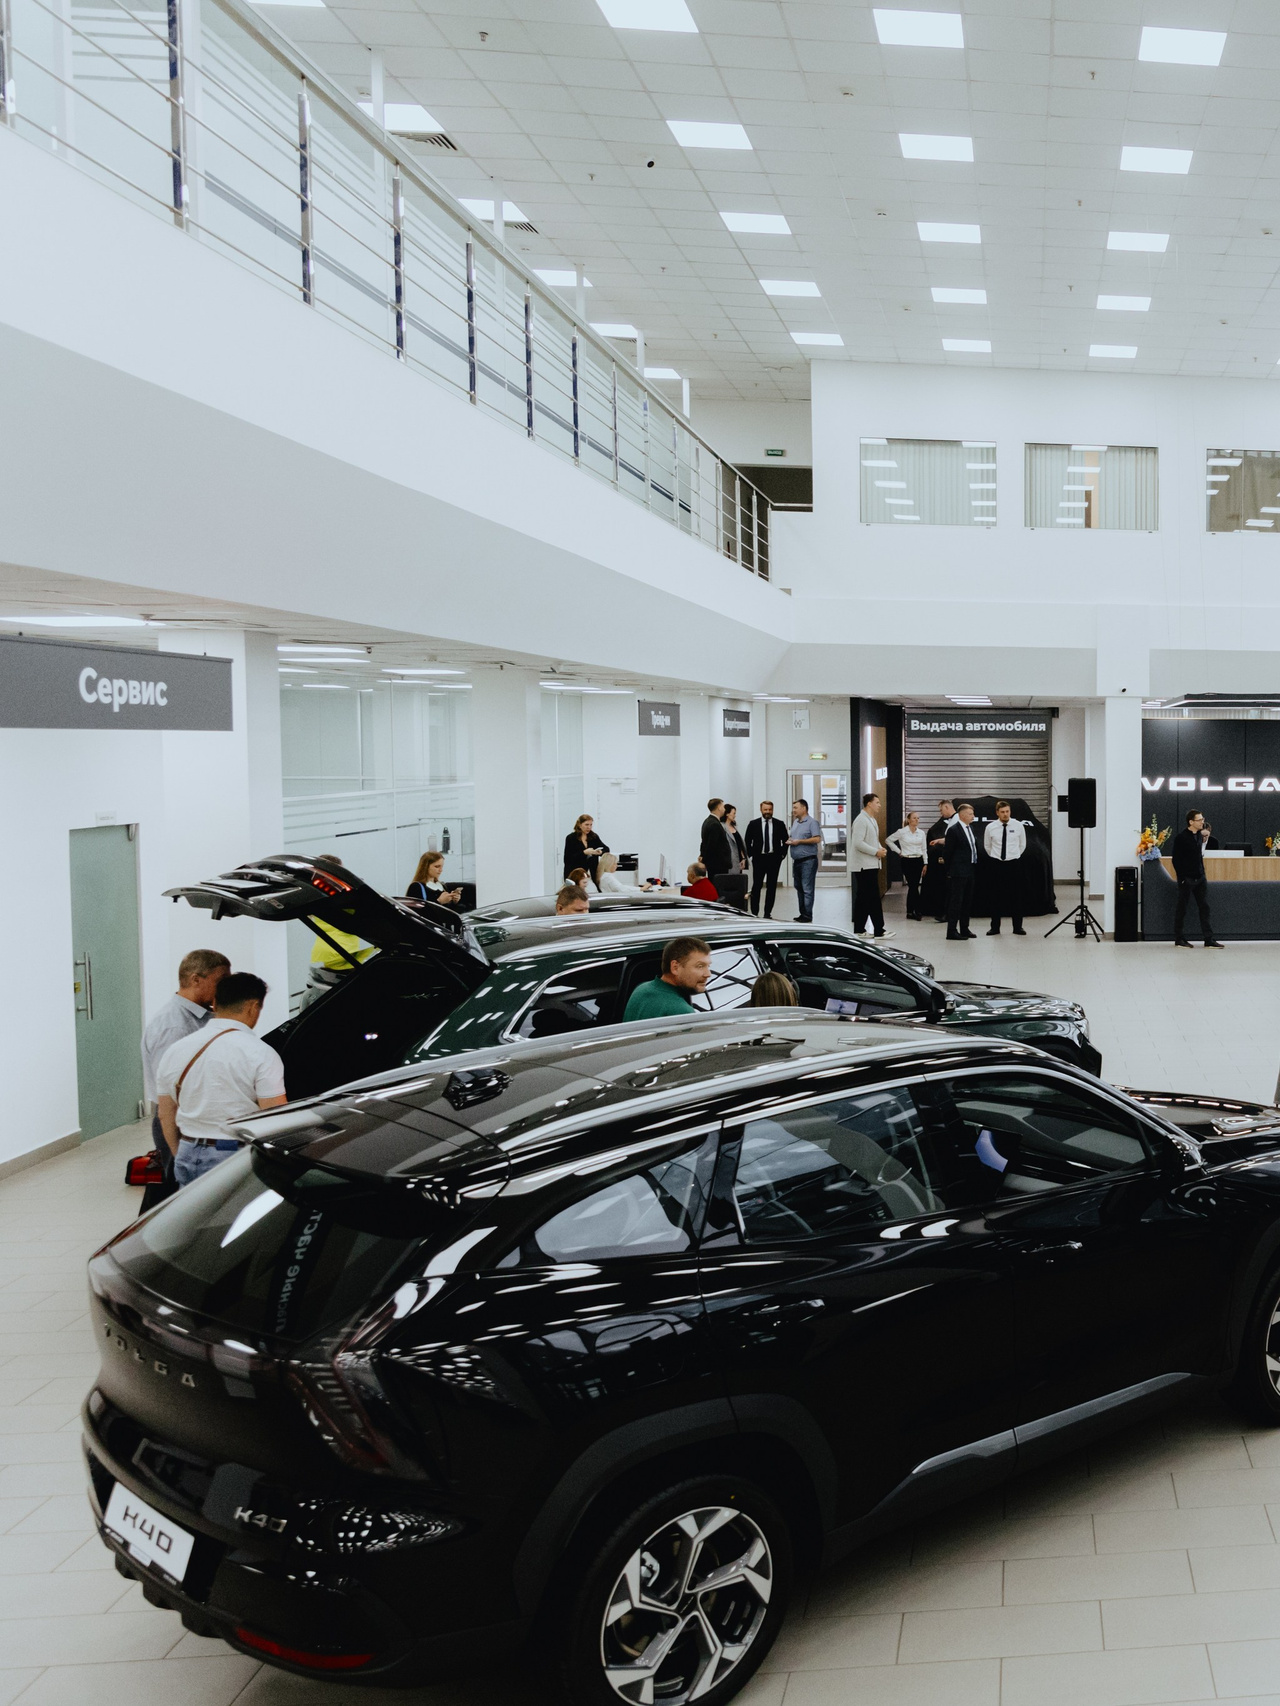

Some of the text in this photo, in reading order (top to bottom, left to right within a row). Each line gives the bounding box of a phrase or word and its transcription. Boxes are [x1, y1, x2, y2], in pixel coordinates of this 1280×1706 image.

[78, 667, 168, 713] Сервис
[910, 719, 1046, 732] Выдача автомобиля
[122, 1505, 174, 1555] K40
[233, 1506, 288, 1534] K40
